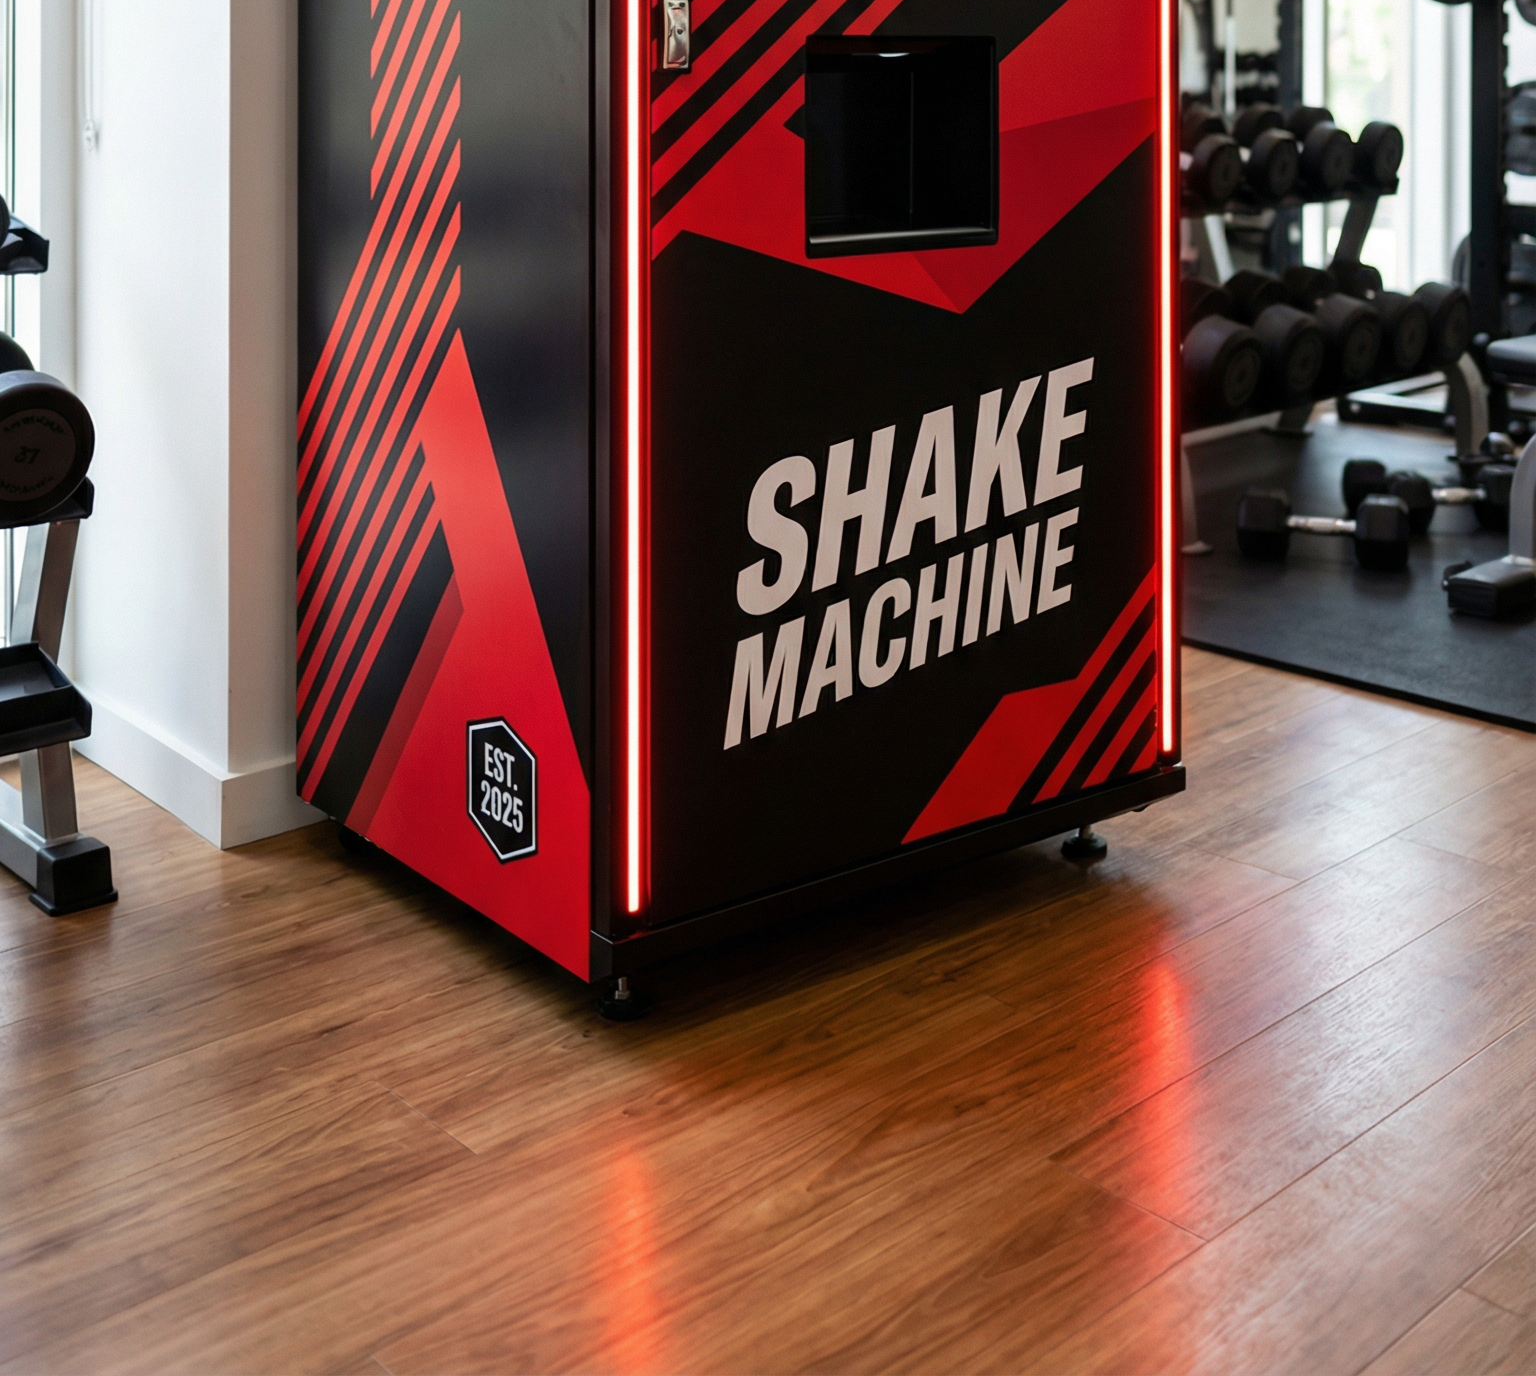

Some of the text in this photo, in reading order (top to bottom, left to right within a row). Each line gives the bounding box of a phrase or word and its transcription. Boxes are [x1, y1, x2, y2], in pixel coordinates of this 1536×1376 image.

[736, 356, 1095, 616] SHAKE
[723, 506, 1080, 751] MACHINE
[480, 780, 524, 833] 2025
[484, 741, 518, 791] EST.
